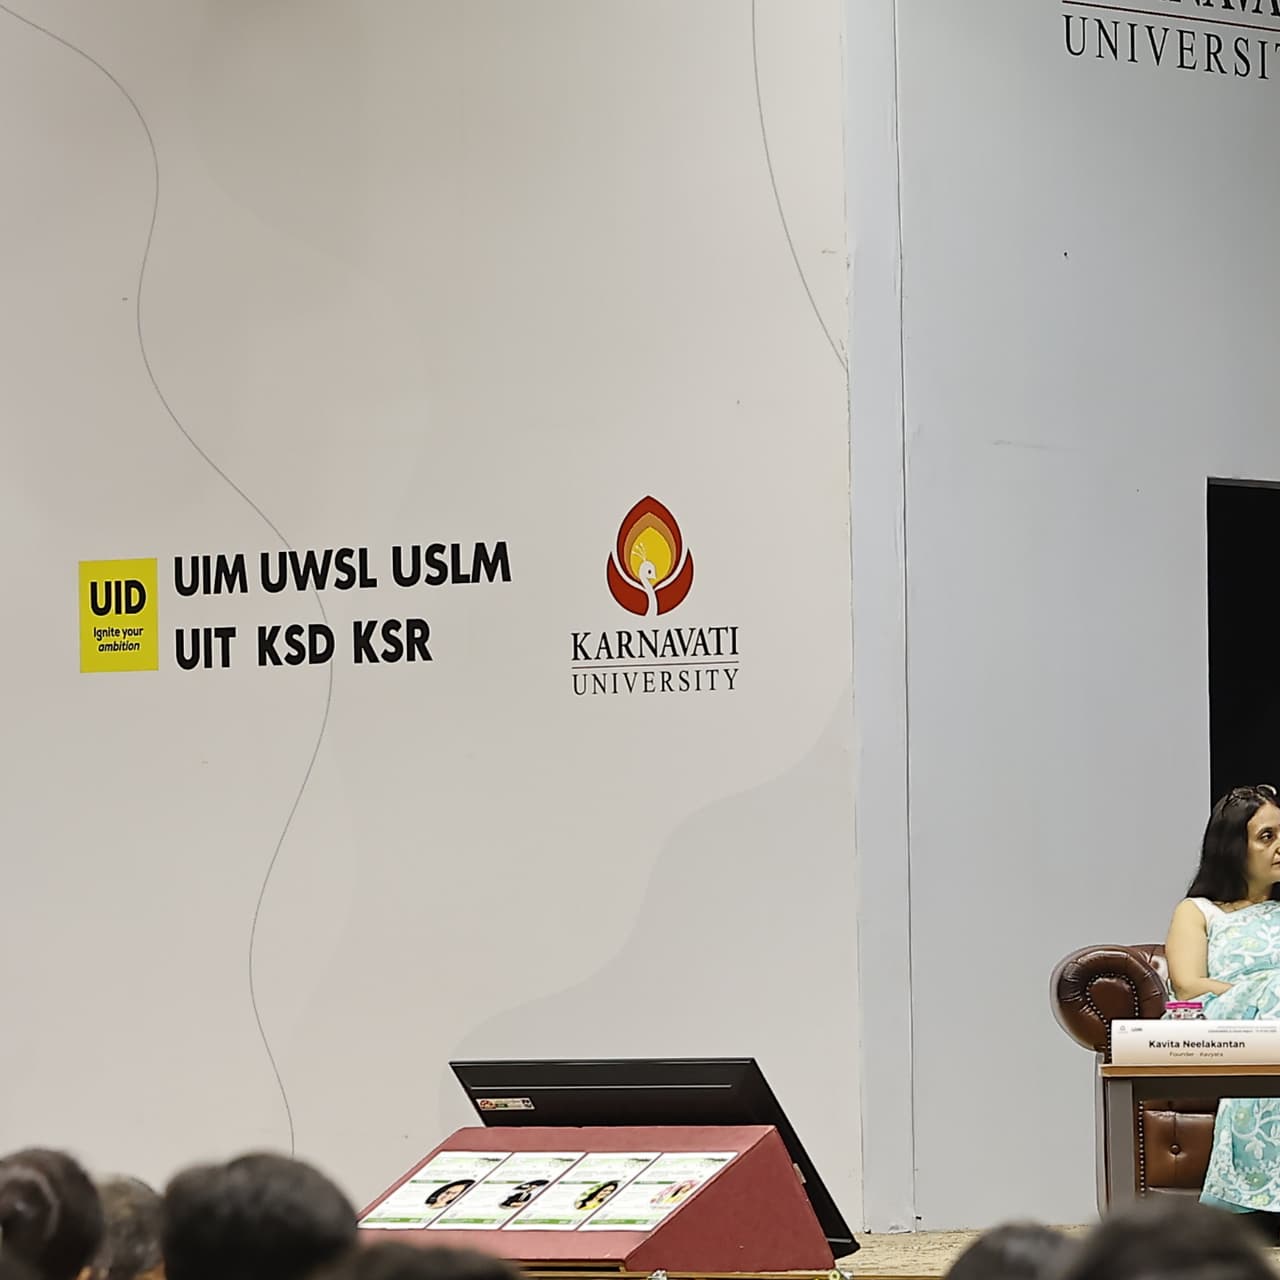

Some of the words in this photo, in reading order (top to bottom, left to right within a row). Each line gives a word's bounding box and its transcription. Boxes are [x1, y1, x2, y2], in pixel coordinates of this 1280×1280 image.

[174, 554, 248, 597] UIM
[260, 547, 377, 593] UWSL
[392, 542, 512, 587] USLM
[90, 580, 146, 616] UID
[94, 626, 120, 642] Ignite
[122, 627, 144, 639] your
[98, 641, 140, 653] ambition
[175, 627, 236, 670] UIT
[258, 624, 335, 666] KSD
[353, 619, 432, 664] KSR
[571, 626, 739, 661] KARNAVATI
[572, 668, 739, 695] UNIVERSITY
[1149, 1039, 1180, 1049] Kavita
[1182, 1039, 1246, 1049] Neelakantan
